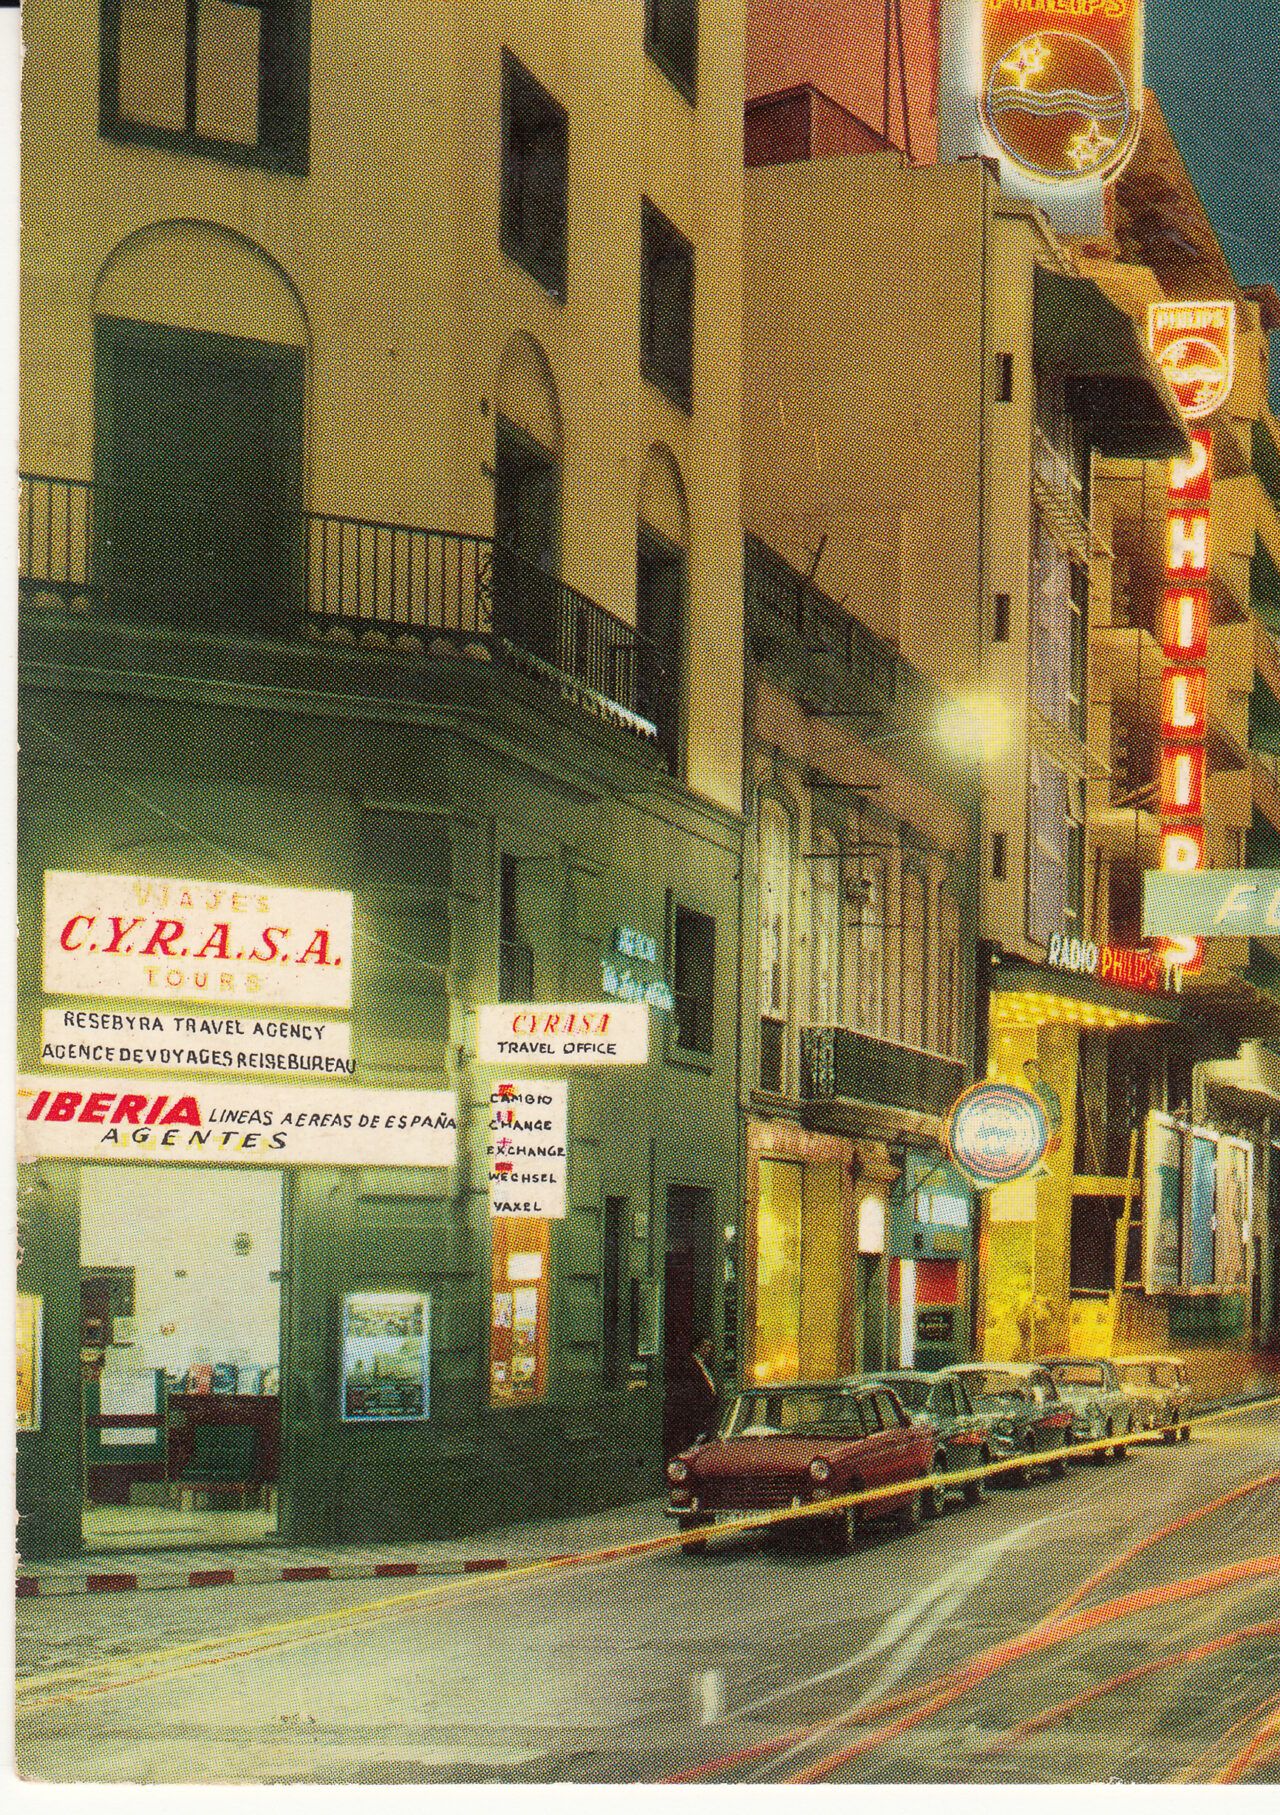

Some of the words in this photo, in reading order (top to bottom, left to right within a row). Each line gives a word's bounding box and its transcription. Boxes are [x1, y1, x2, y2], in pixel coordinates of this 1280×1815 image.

[1157, 309, 1225, 329] PHILIPS
[1163, 438, 1207, 966] PHILIPS
[133, 882, 271, 914] VIAJES
[59, 913, 343, 967] C.Y.R.A.S.A.
[1048, 932, 1098, 975] RADIO
[1101, 945, 1157, 990] PHILIPS
[143, 965, 262, 992] TOURS
[64, 1010, 164, 1032] RESEBYRA
[173, 1016, 245, 1036] TRAVEL
[252, 1022, 326, 1041] AGENCY
[511, 1012, 611, 1036] CYRASA
[41, 1043, 116, 1062] AGENCE
[236, 1052, 357, 1075] REISEBUREAU
[497, 1041, 556, 1055] TRAVEL
[562, 1042, 617, 1056] OFFICE
[26, 1089, 202, 1127] IBERIA
[207, 1108, 274, 1127] LINEAS
[280, 1111, 352, 1129] AEREAS
[358, 1113, 380, 1129] DE
[385, 1111, 457, 1131] ESPAÑA
[489, 1092, 553, 1105] CAMBIO
[488, 1119, 553, 1131] CHANGE
[99, 1127, 288, 1151] AGENTES
[486, 1145, 567, 1157] EXCHANGE
[488, 1171, 557, 1184] WECHSEL
[493, 1200, 542, 1213] VAXEL
